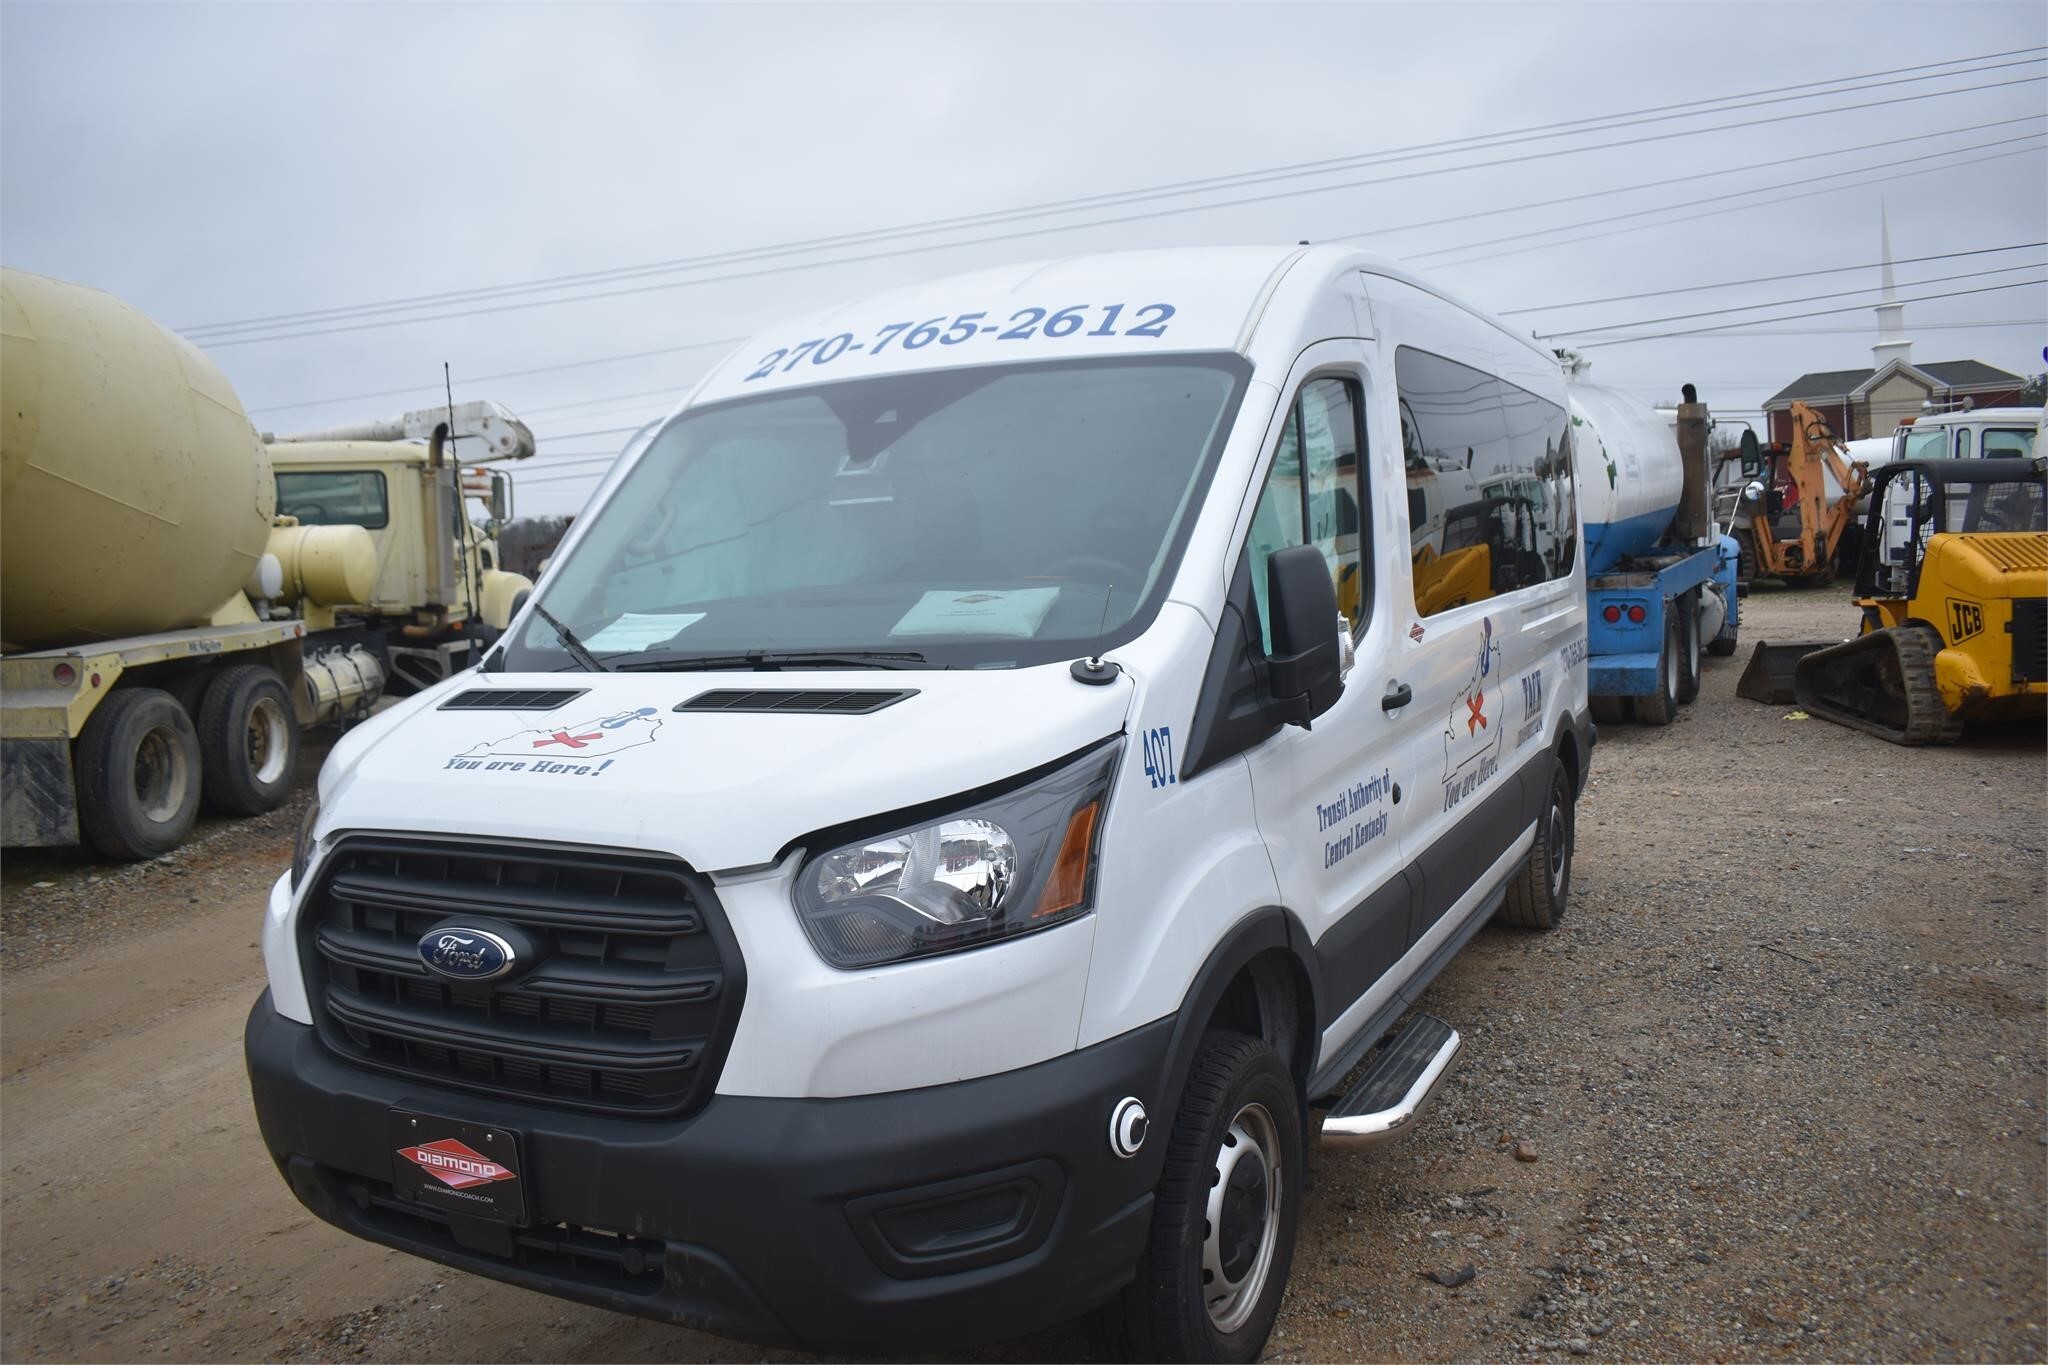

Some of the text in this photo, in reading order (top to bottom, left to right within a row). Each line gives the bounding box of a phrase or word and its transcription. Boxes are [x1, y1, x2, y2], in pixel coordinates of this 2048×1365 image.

[743, 303, 1176, 382] 270-765-2612
[1952, 603, 1982, 640] JCB
[443, 758, 615, 777] You are Here!
[1143, 726, 1176, 789] 407
[1316, 768, 1390, 833] Transit Authority of
[1443, 781, 1461, 813] You
[1462, 770, 1477, 798] are
[1325, 809, 1388, 869] Central Kentucky
[432, 935, 486, 969] Ford
